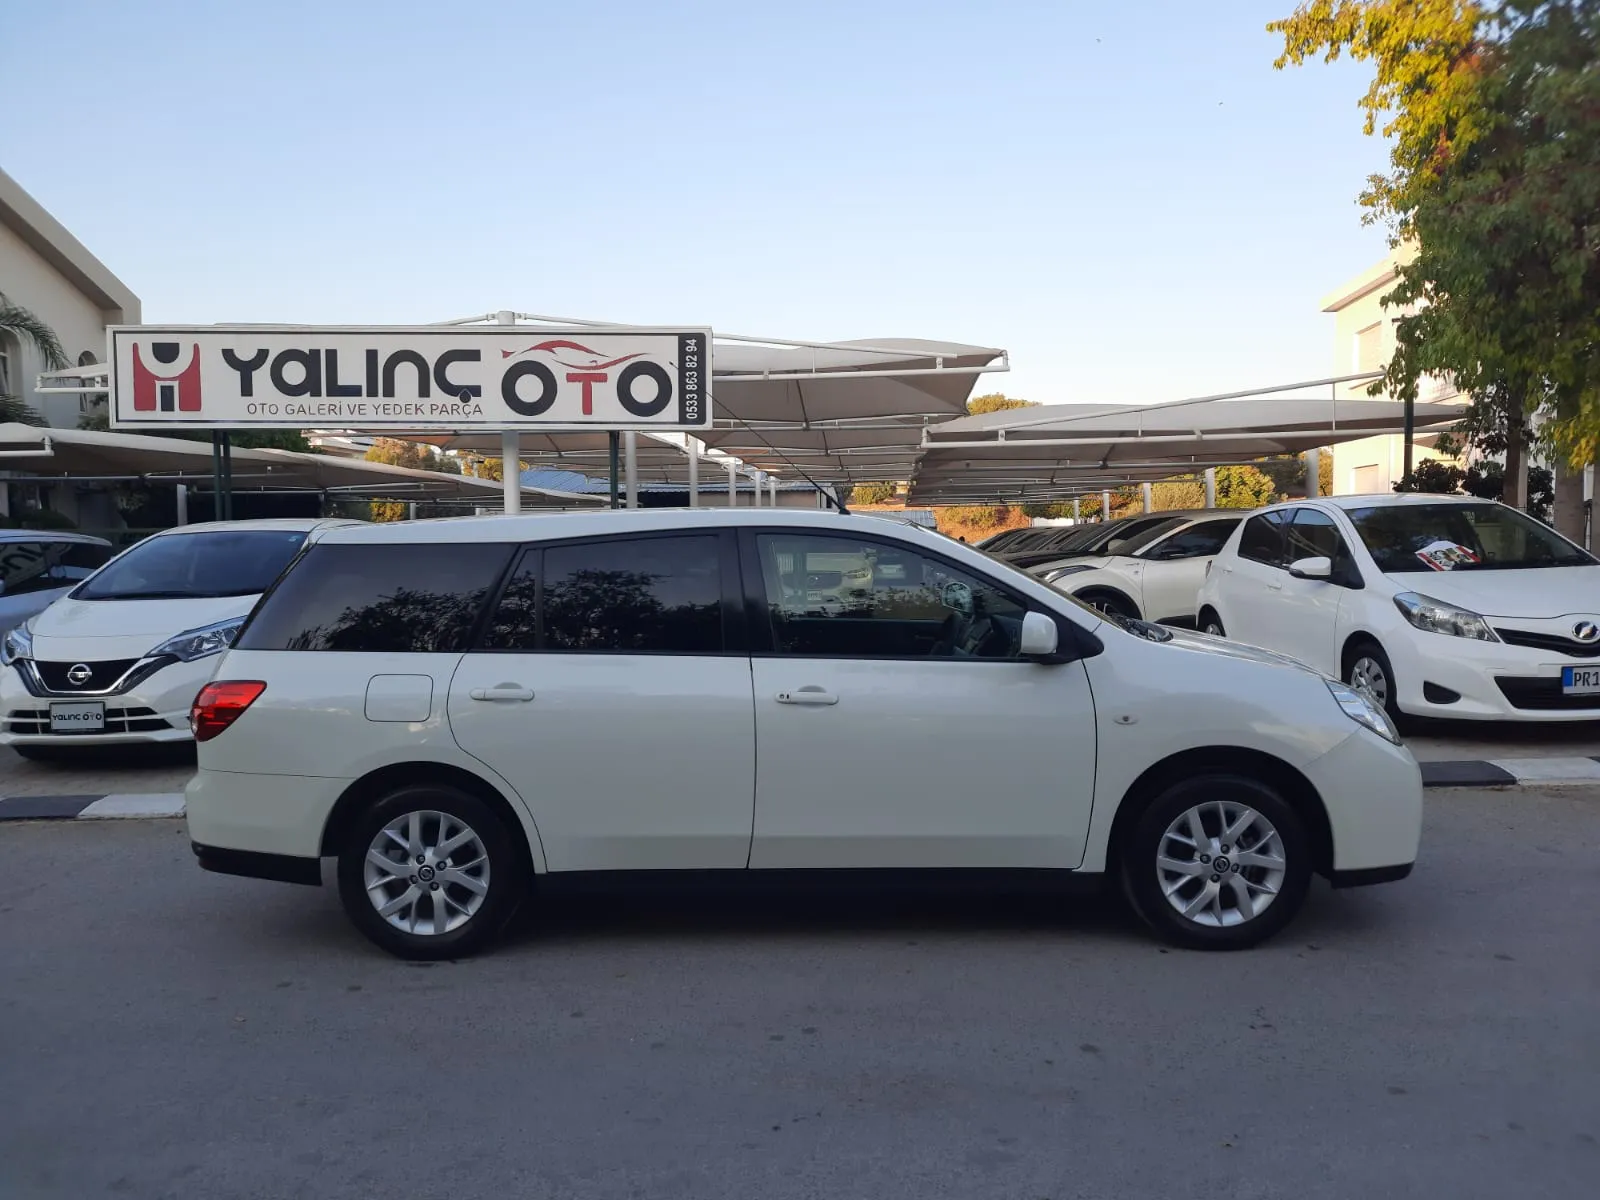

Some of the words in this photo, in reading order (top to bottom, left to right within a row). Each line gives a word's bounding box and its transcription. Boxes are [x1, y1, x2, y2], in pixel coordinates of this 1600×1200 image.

[685, 338, 698, 352] 94
[685, 355, 698, 368] 82
[500, 360, 673, 417] OTO
[685, 371, 698, 391] 863
[246, 403, 279, 416] OTO
[284, 400, 342, 416] GALERİ
[346, 403, 367, 416] VE
[372, 403, 426, 416] YEDEK
[429, 402, 483, 419] PARÇA
[685, 393, 698, 419] 0533
